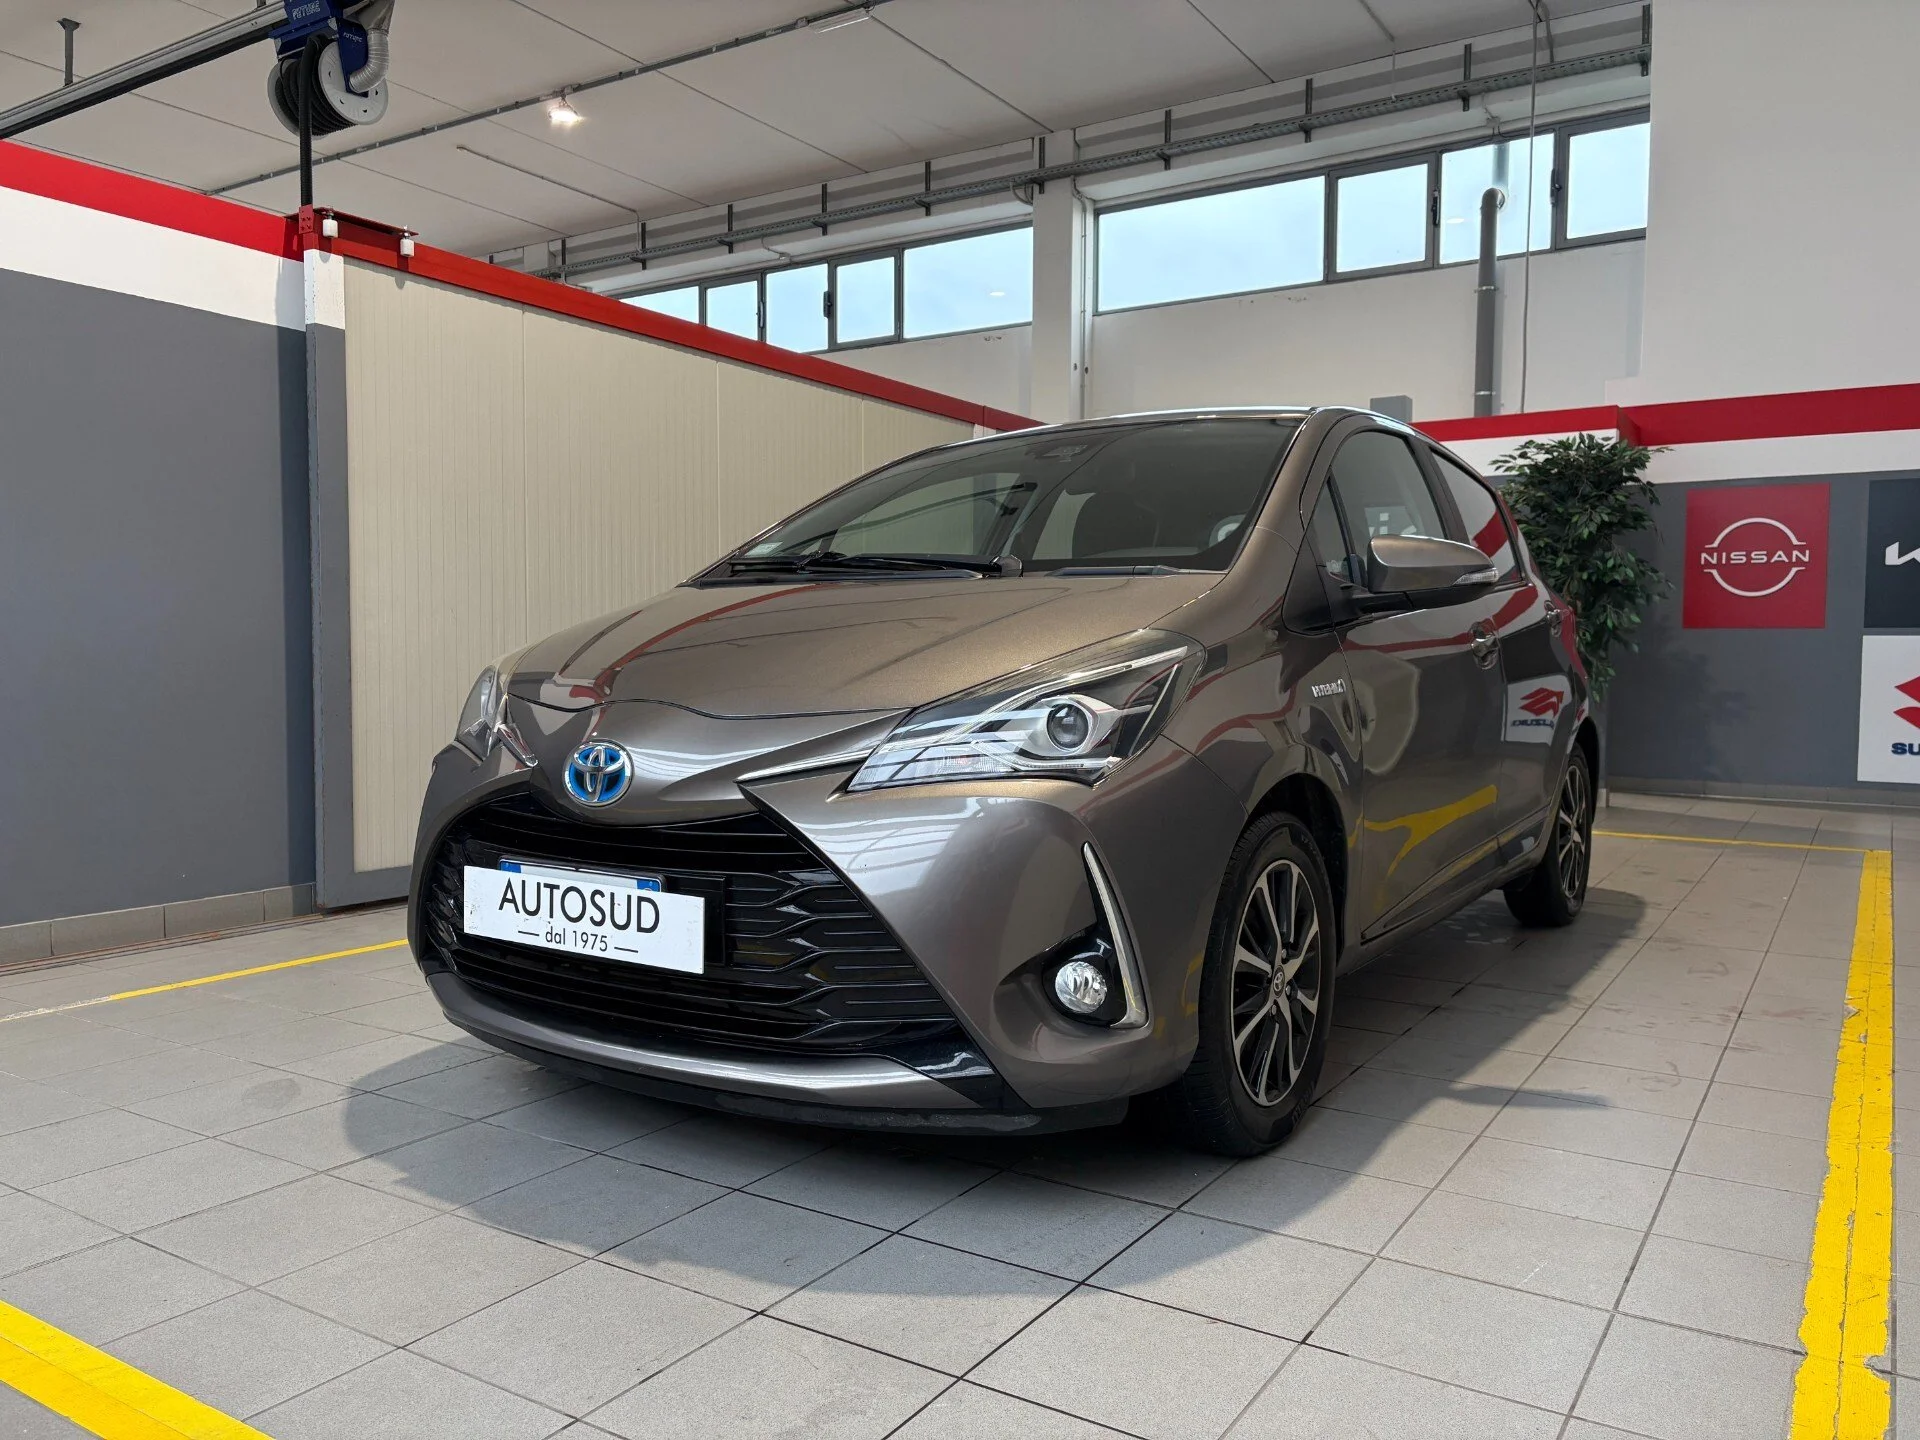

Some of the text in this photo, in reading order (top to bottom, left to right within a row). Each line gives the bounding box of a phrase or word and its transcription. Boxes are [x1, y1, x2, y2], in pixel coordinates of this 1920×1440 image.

[1700, 549, 1810, 566] NISSAN
[1891, 742, 1920, 756] SU
[498, 877, 660, 934] AUTOSUD
[545, 925, 608, 952] dal 1975
